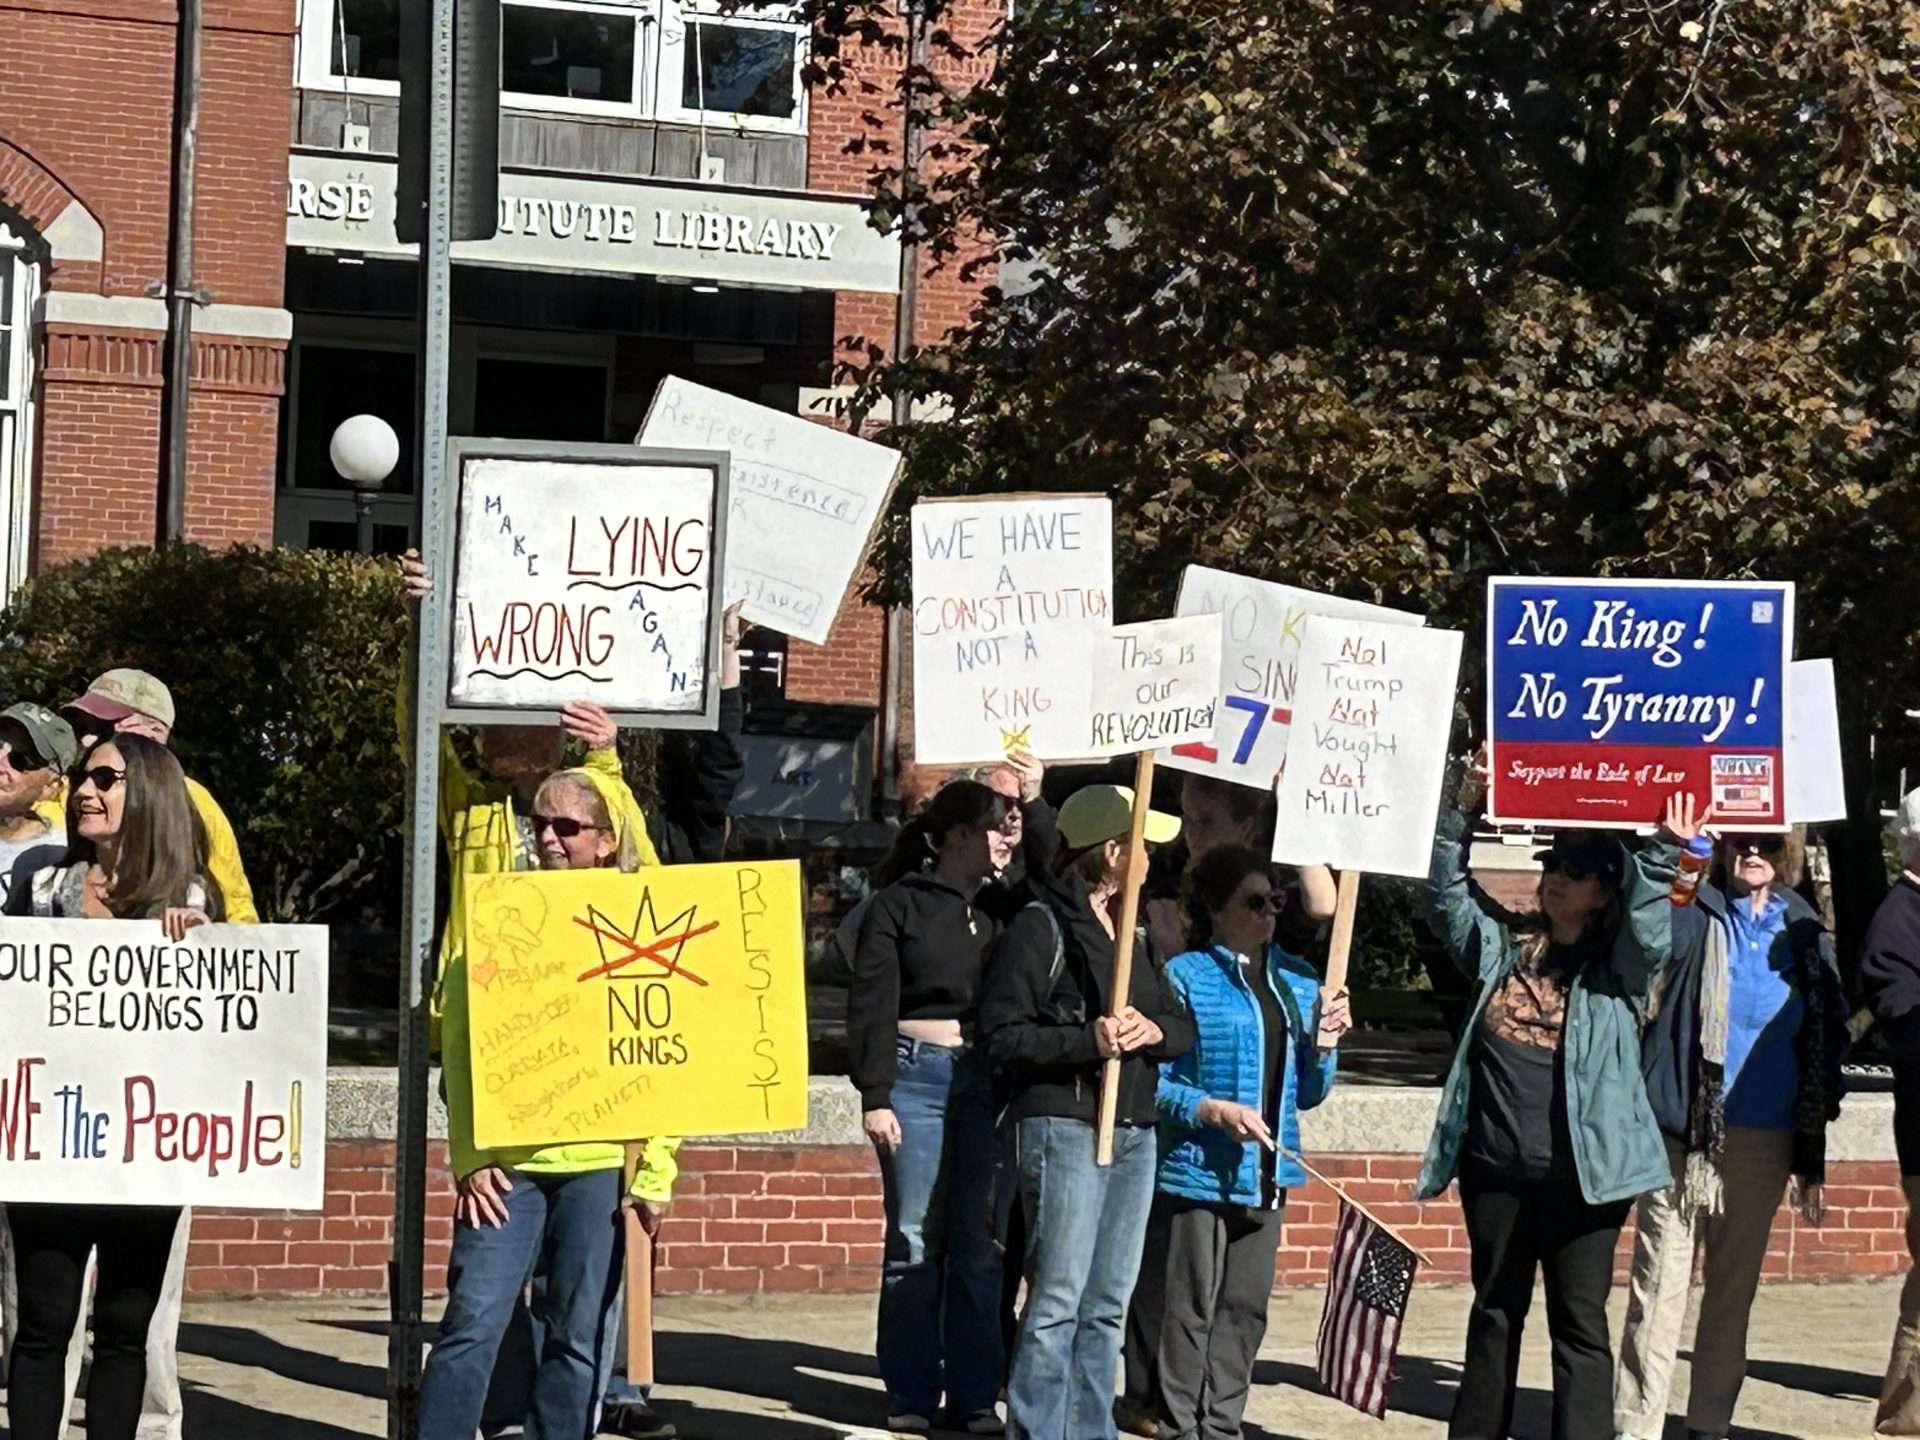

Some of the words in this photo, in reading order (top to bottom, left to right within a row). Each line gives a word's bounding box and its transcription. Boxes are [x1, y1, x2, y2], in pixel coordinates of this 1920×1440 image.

[287, 178, 374, 220] RSE
[499, 197, 638, 243] ITUTE
[654, 209, 843, 261] LIBRARY
[485, 495, 539, 576] MAKE
[568, 515, 704, 577] LYING
[923, 517, 980, 560] WE
[1000, 512, 1081, 554] HAVE
[997, 564, 1016, 591] A
[468, 602, 615, 667] WRONG
[629, 589, 687, 692] AGAIN
[1507, 599, 1568, 647] No
[957, 636, 1008, 672] NOT
[1024, 630, 1039, 661] A
[1113, 635, 1164, 670] This
[1235, 655, 1298, 702] SIN
[1320, 662, 1404, 701] Trump
[1507, 672, 1567, 720] No
[981, 686, 1052, 722] KING
[1329, 697, 1380, 727] Not
[1312, 721, 1397, 763] Vought
[1320, 758, 1368, 788] Not
[1305, 788, 1391, 817] Miller
[88, 944, 300, 994] GOVERNMENT
[48, 990, 204, 1031] BELONGS
[215, 994, 258, 1032] TO
[609, 983, 671, 1032] NO
[737, 867, 782, 1121] RESIST
[609, 1033, 688, 1066] KINGS
